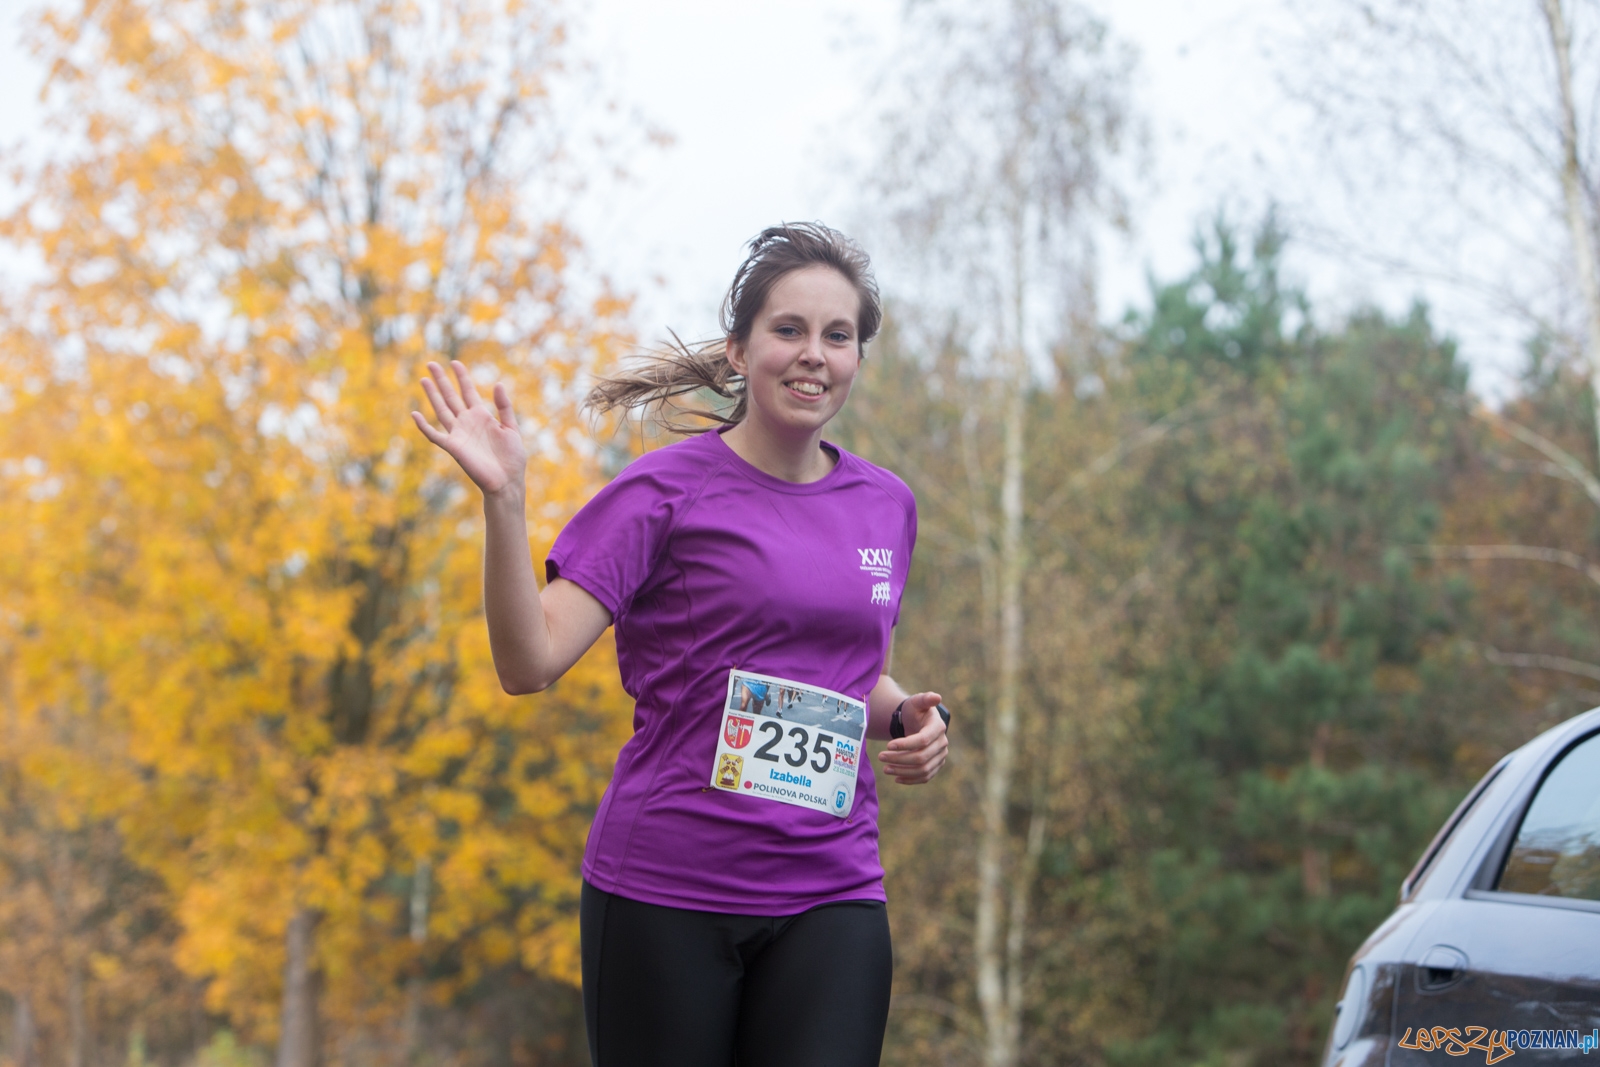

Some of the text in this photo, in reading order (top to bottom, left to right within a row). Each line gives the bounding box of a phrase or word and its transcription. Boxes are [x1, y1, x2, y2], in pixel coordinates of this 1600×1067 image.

[857, 548, 892, 568] XXIX
[753, 721, 834, 773] 235
[769, 768, 812, 788] Izabella
[753, 783, 797, 799] POLINOVA
[799, 792, 827, 806] POLSKA
